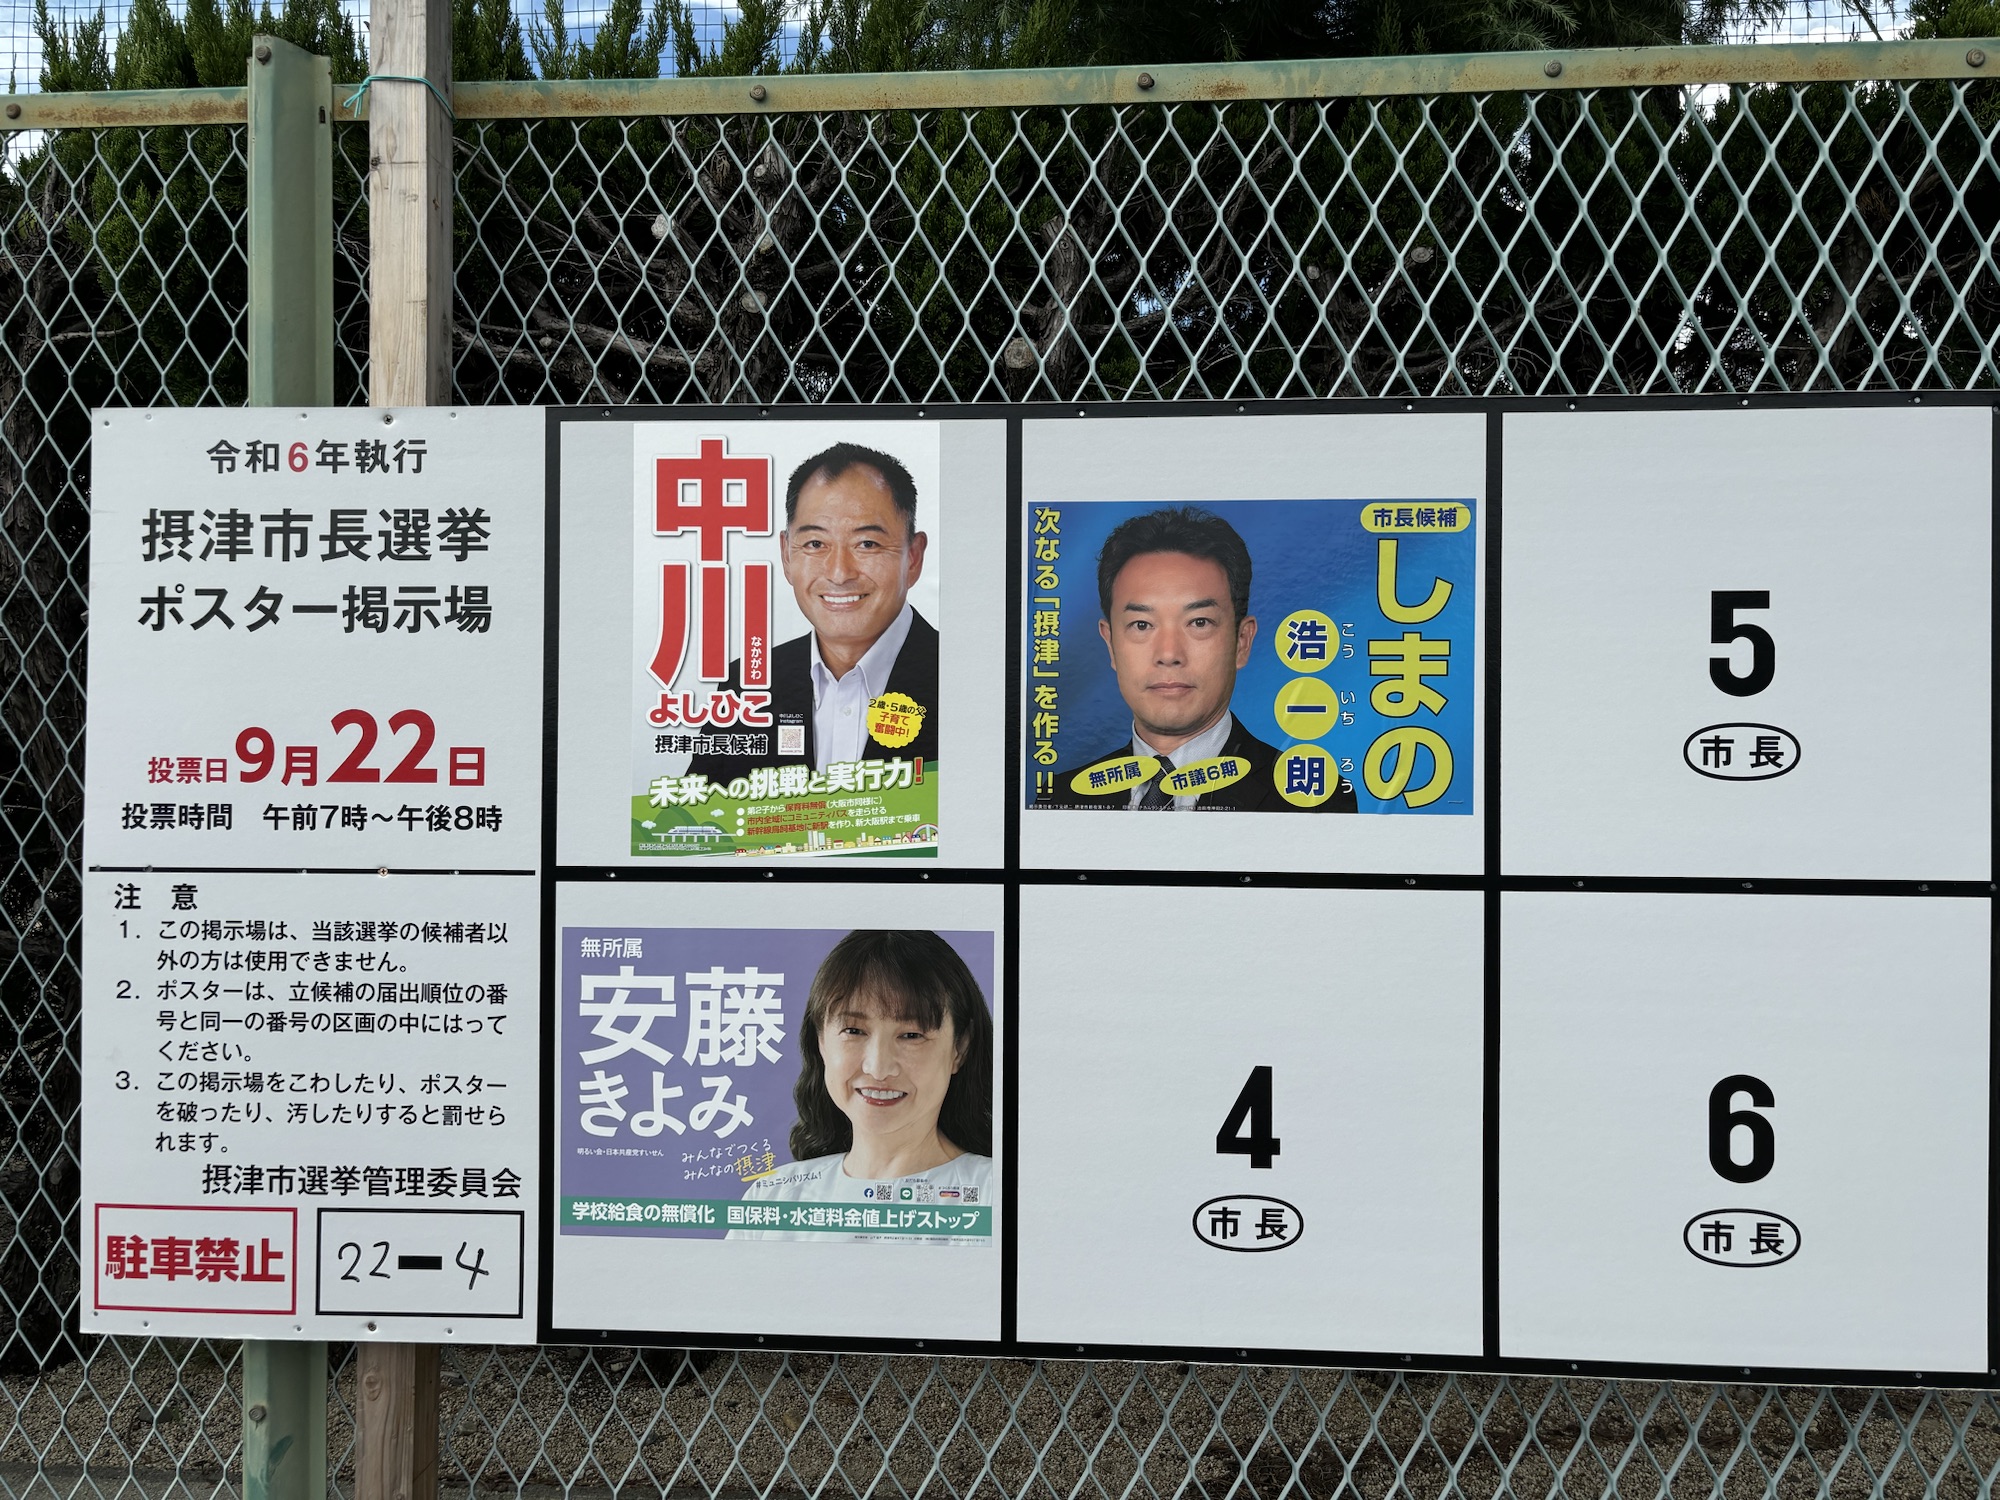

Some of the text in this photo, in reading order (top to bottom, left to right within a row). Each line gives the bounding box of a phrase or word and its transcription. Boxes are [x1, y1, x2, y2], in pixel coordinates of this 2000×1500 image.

[206, 439, 428, 474] 令和6年執行
[1372, 507, 1458, 528] 市長候補
[141, 507, 492, 563] 摂津市長選挙
[648, 435, 773, 688] 中川
[138, 582, 493, 634] ポスター掲示場
[750, 635, 763, 680] なかがわ
[1709, 590, 1776, 698] 5
[1362, 538, 1455, 809] しまの
[647, 690, 772, 729] よしひこ
[868, 697, 926, 719] 2歳・5歳の父
[879, 711, 911, 727] 子育て
[654, 733, 769, 755] 摂津市長候補
[649, 757, 924, 809] 未来への挑戦と実行力!
[1088, 761, 1143, 789] 無所属
[1170, 760, 1240, 792] 市議6期
[122, 802, 234, 831] 投票時間
[158, 919, 509, 944] この掲示場は、当該選挙の候補者以
[157, 949, 411, 973] 外の方は使用できません。
[580, 938, 643, 959] 無所属
[156, 979, 509, 1005] ポスターは、立候補の届出順位の番
[156, 1010, 508, 1035] 号と同一の番号の区画の中にはって
[579, 965, 786, 1067] 安藤
[156, 1040, 254, 1063] ください。
[156, 1070, 508, 1095] この掲示場をこわしたり、ポスター
[156, 1101, 507, 1126] を破ったり、汚したりすると罰せら
[578, 1070, 755, 1139] きよみ
[1216, 1065, 1281, 1170] 4
[155, 1131, 230, 1154] れます。
[1708, 1074, 1776, 1184] 6
[681, 1138, 772, 1163] みんなでつくる
[683, 1151, 777, 1181] みんなの摂津
[201, 1163, 523, 1199] 摂津市選挙管理委員会
[571, 1201, 981, 1230] 学校給食の無償化 国保料・水道料金値上げストップ
[104, 1233, 286, 1284] 駐車禁止
